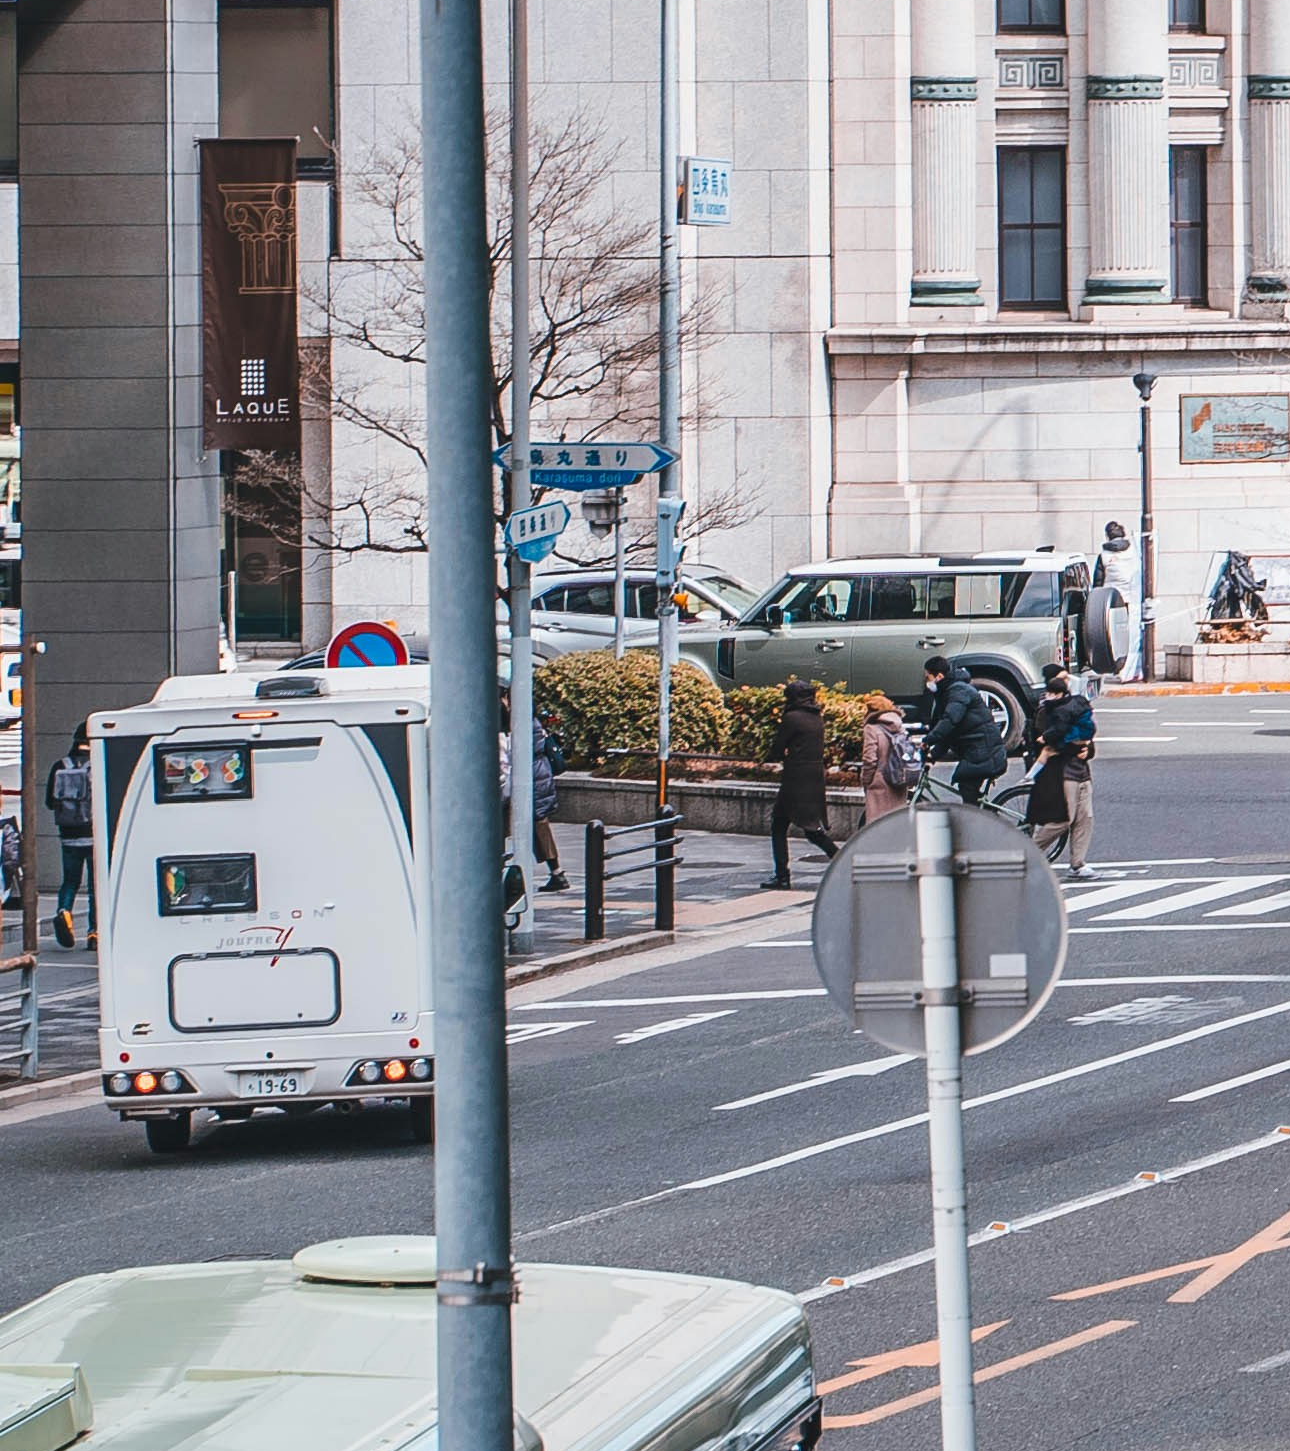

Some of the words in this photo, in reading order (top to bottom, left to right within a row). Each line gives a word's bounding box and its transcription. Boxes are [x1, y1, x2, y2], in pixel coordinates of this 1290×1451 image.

[216, 398, 290, 415] LAQUE
[534, 472, 593, 484] Karasuma
[597, 472, 621, 483] dori
[258, 1078, 297, 1094] 19-69
